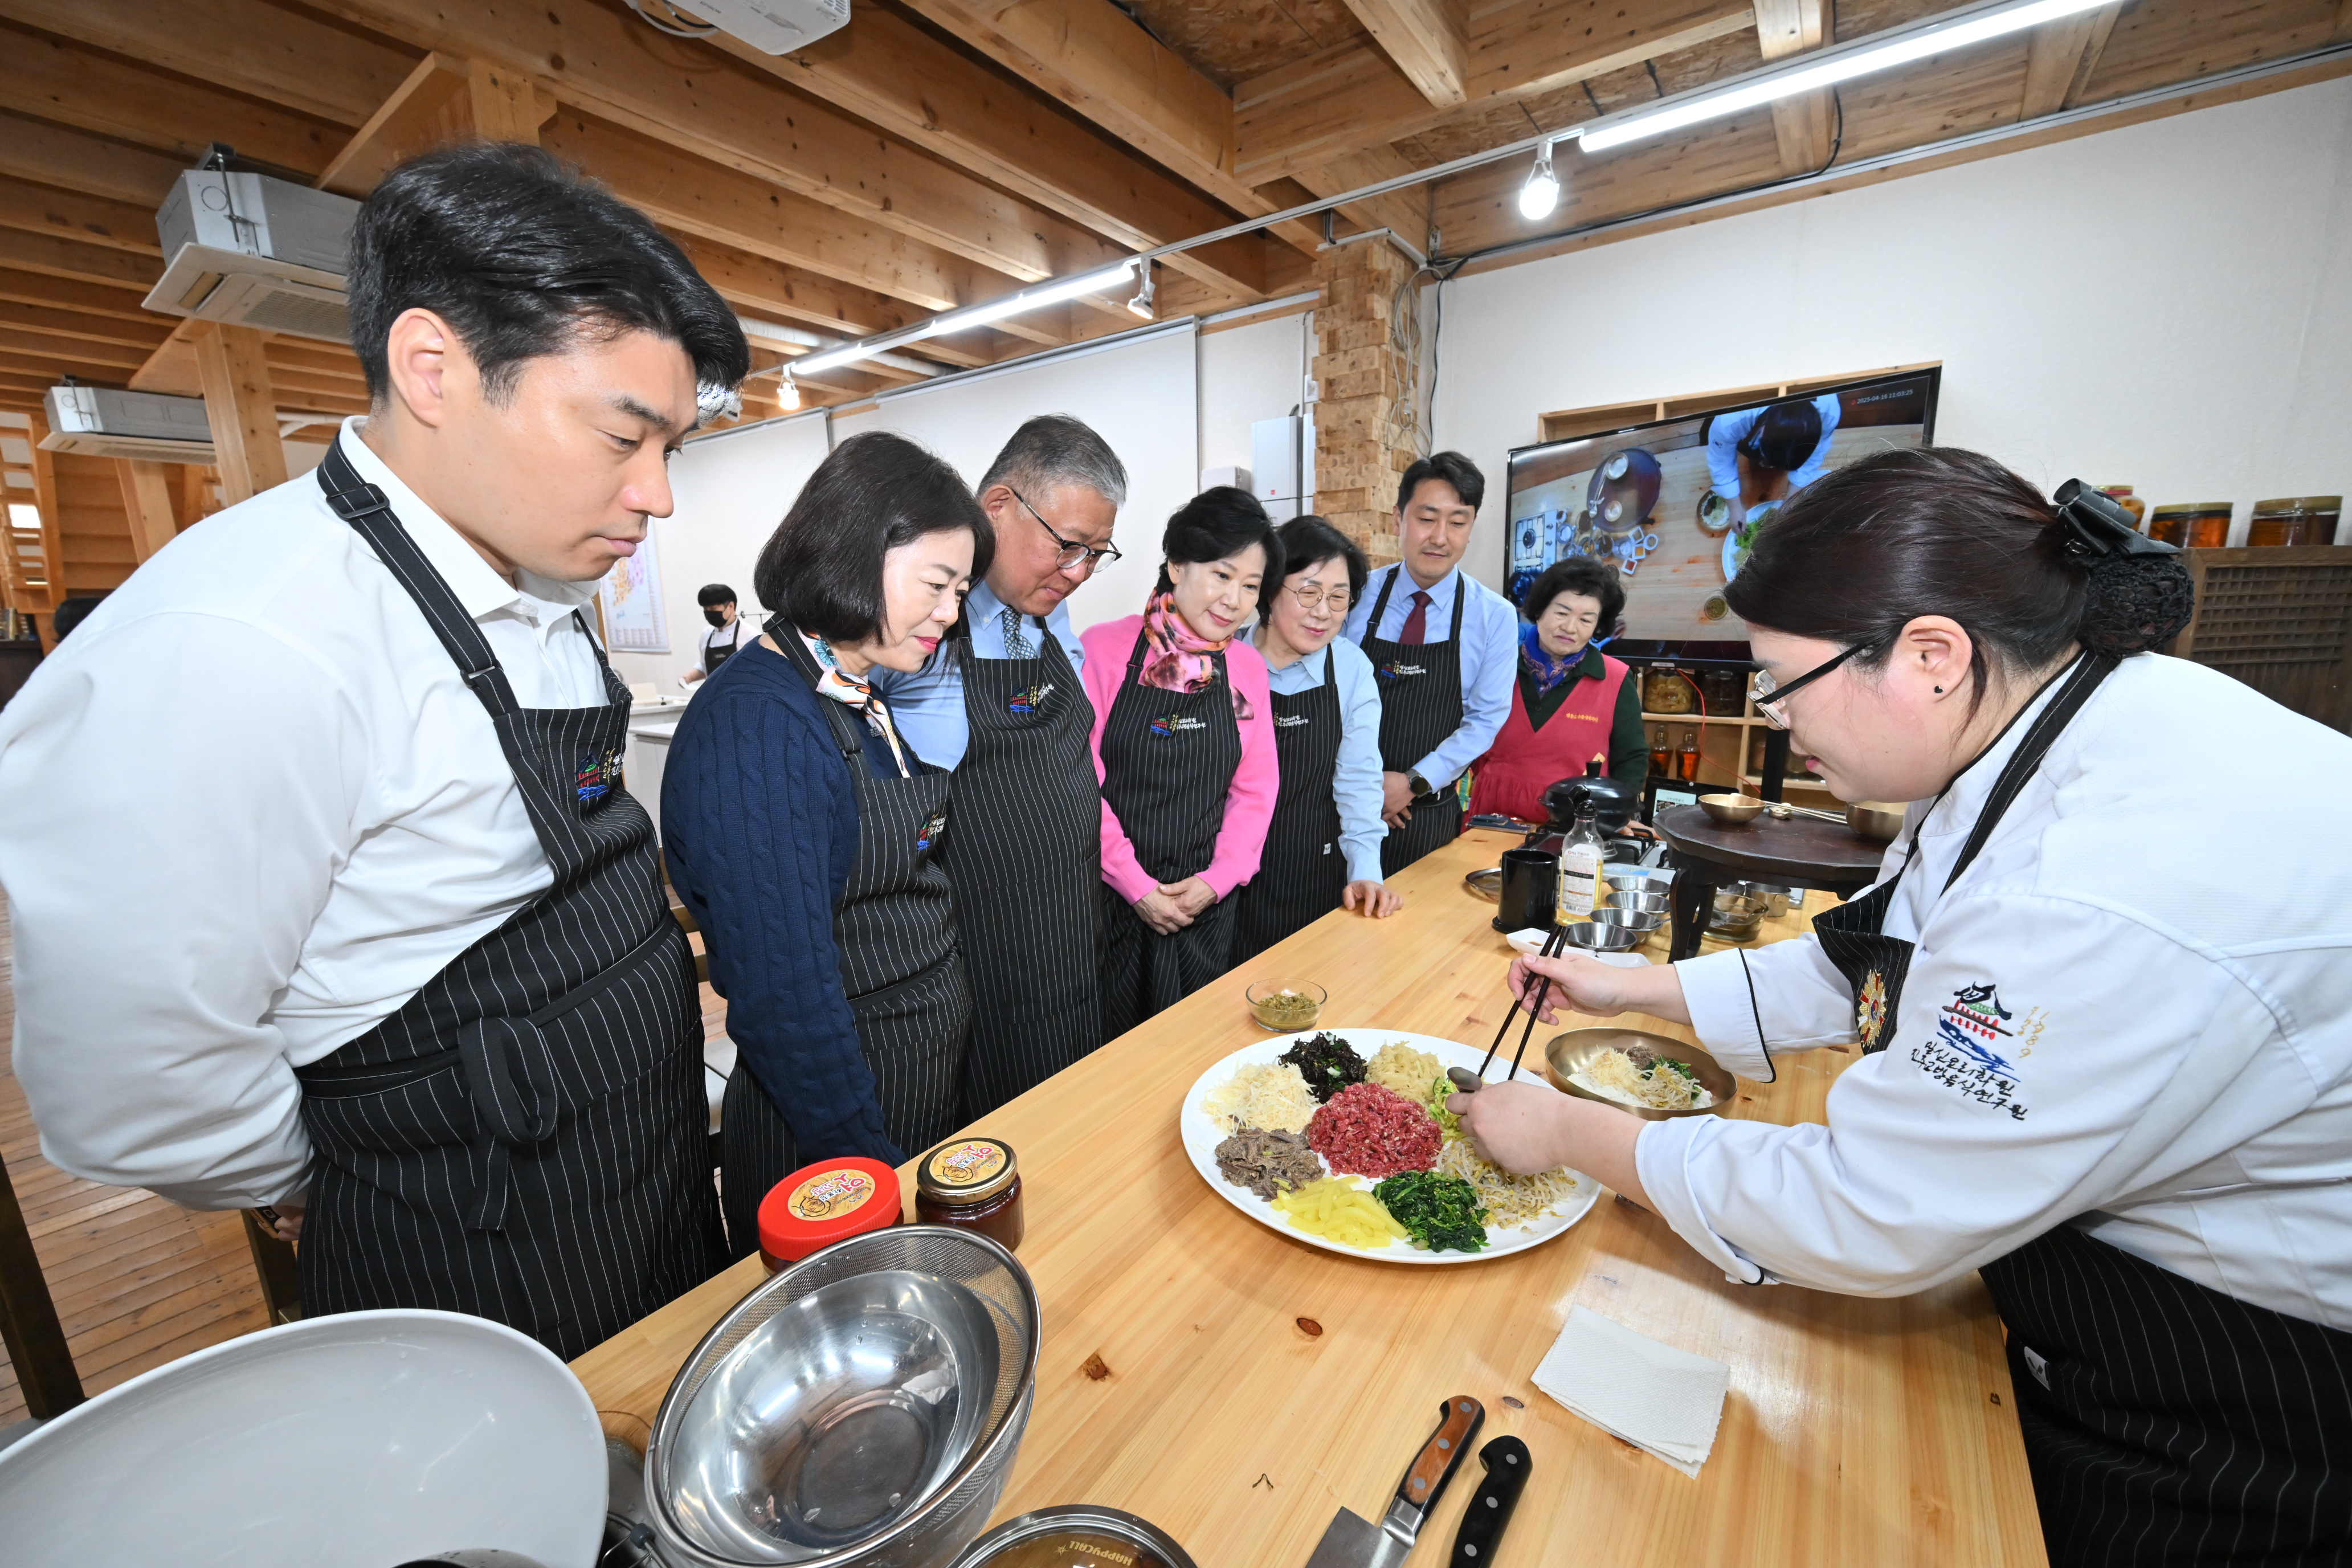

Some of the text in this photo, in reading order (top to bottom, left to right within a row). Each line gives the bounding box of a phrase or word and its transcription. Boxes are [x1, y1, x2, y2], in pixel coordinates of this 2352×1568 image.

[1857, 389, 1913, 404] 2025-04-16 11:03:25
[1069, 1541, 1133, 1566] HAPPYCALL
